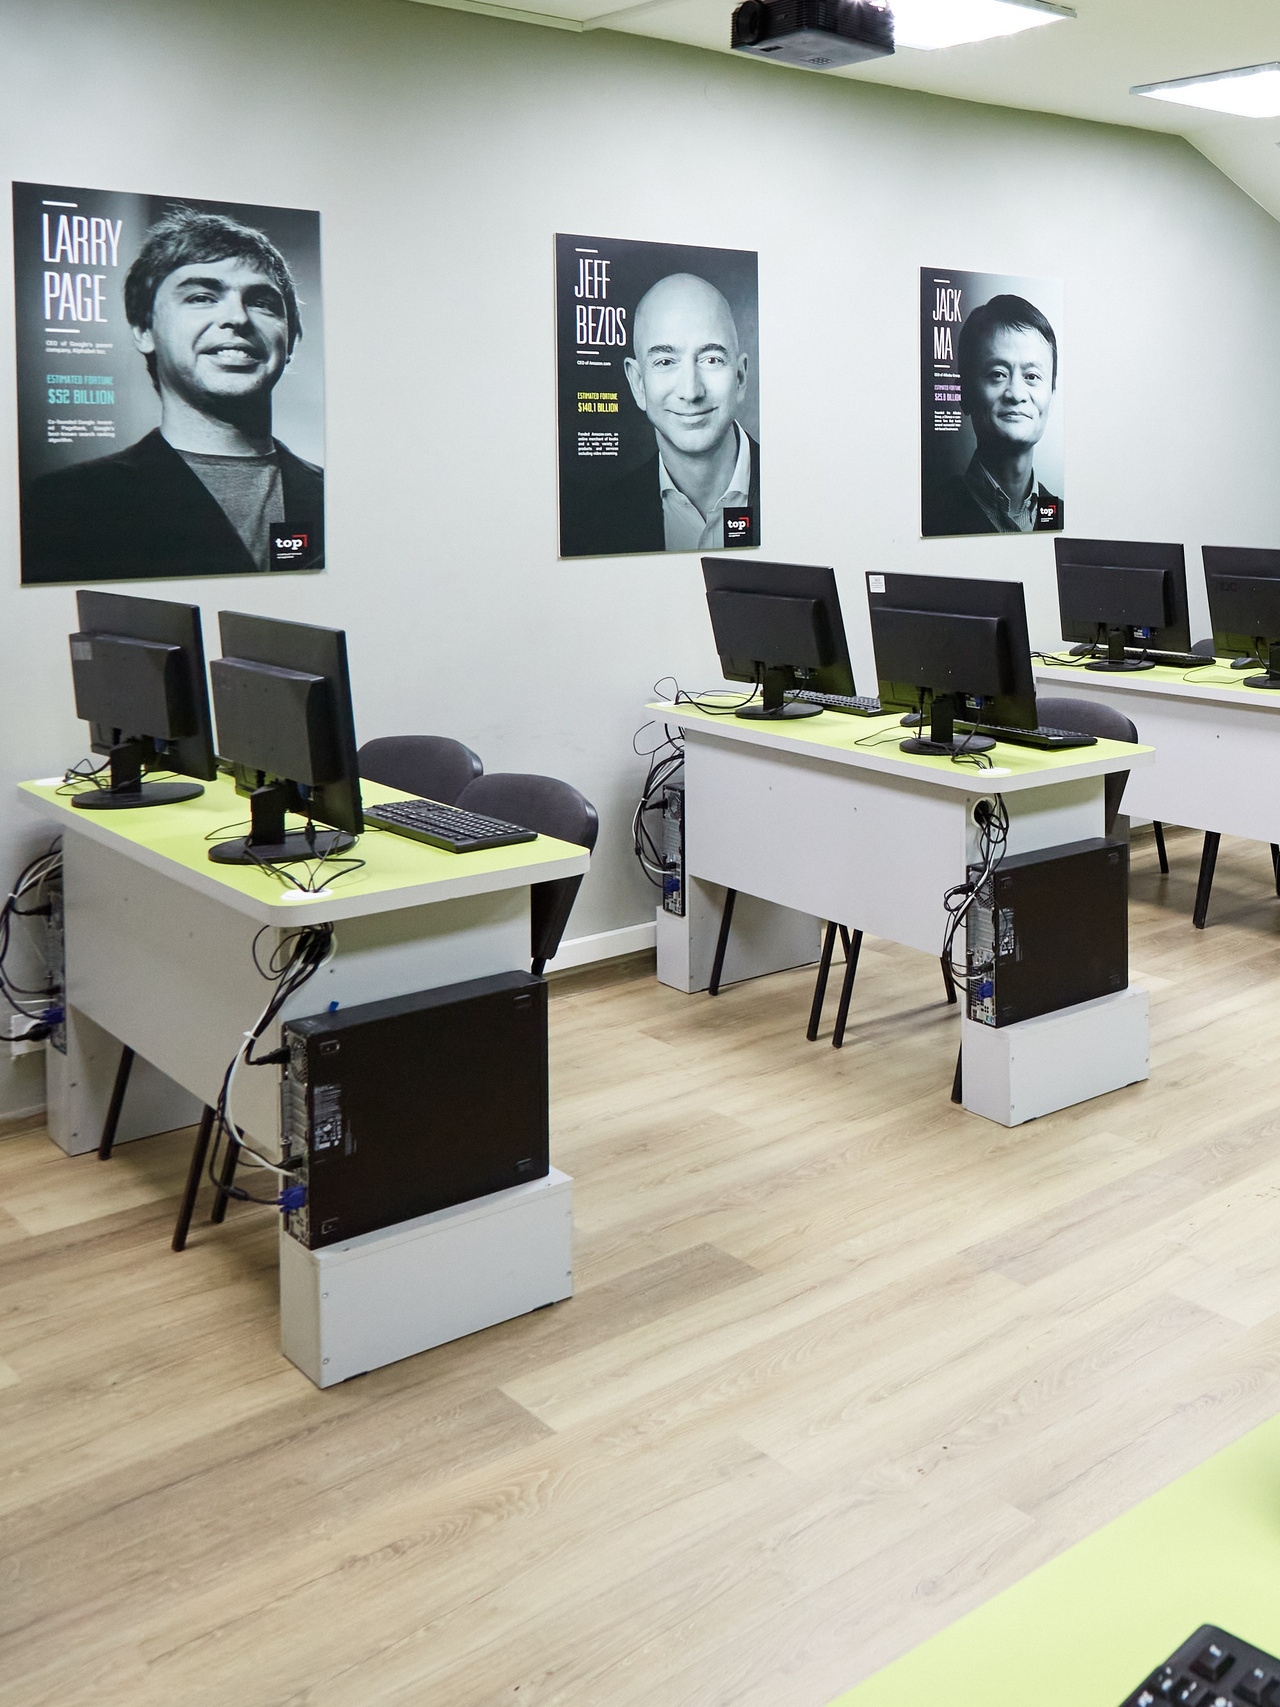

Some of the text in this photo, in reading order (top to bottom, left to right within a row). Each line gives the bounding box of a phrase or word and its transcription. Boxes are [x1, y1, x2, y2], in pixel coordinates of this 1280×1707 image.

[42, 213, 123, 267] LARRY
[574, 258, 611, 299] JEFF
[43, 271, 108, 322] PAGE
[932, 287, 962, 322] JACK
[576, 304, 627, 346] BEZOS
[933, 326, 954, 361] MA
[46, 374, 113, 385] ESTIMATED FORTUNE
[48, 388, 115, 405] $52 BILLION
[577, 392, 618, 400] ESTIMATED FORTUNE
[577, 402, 619, 413] $140.1 BILLION
[1040, 507, 1054, 517] top
[727, 520, 746, 530] top
[275, 538, 303, 550] top
